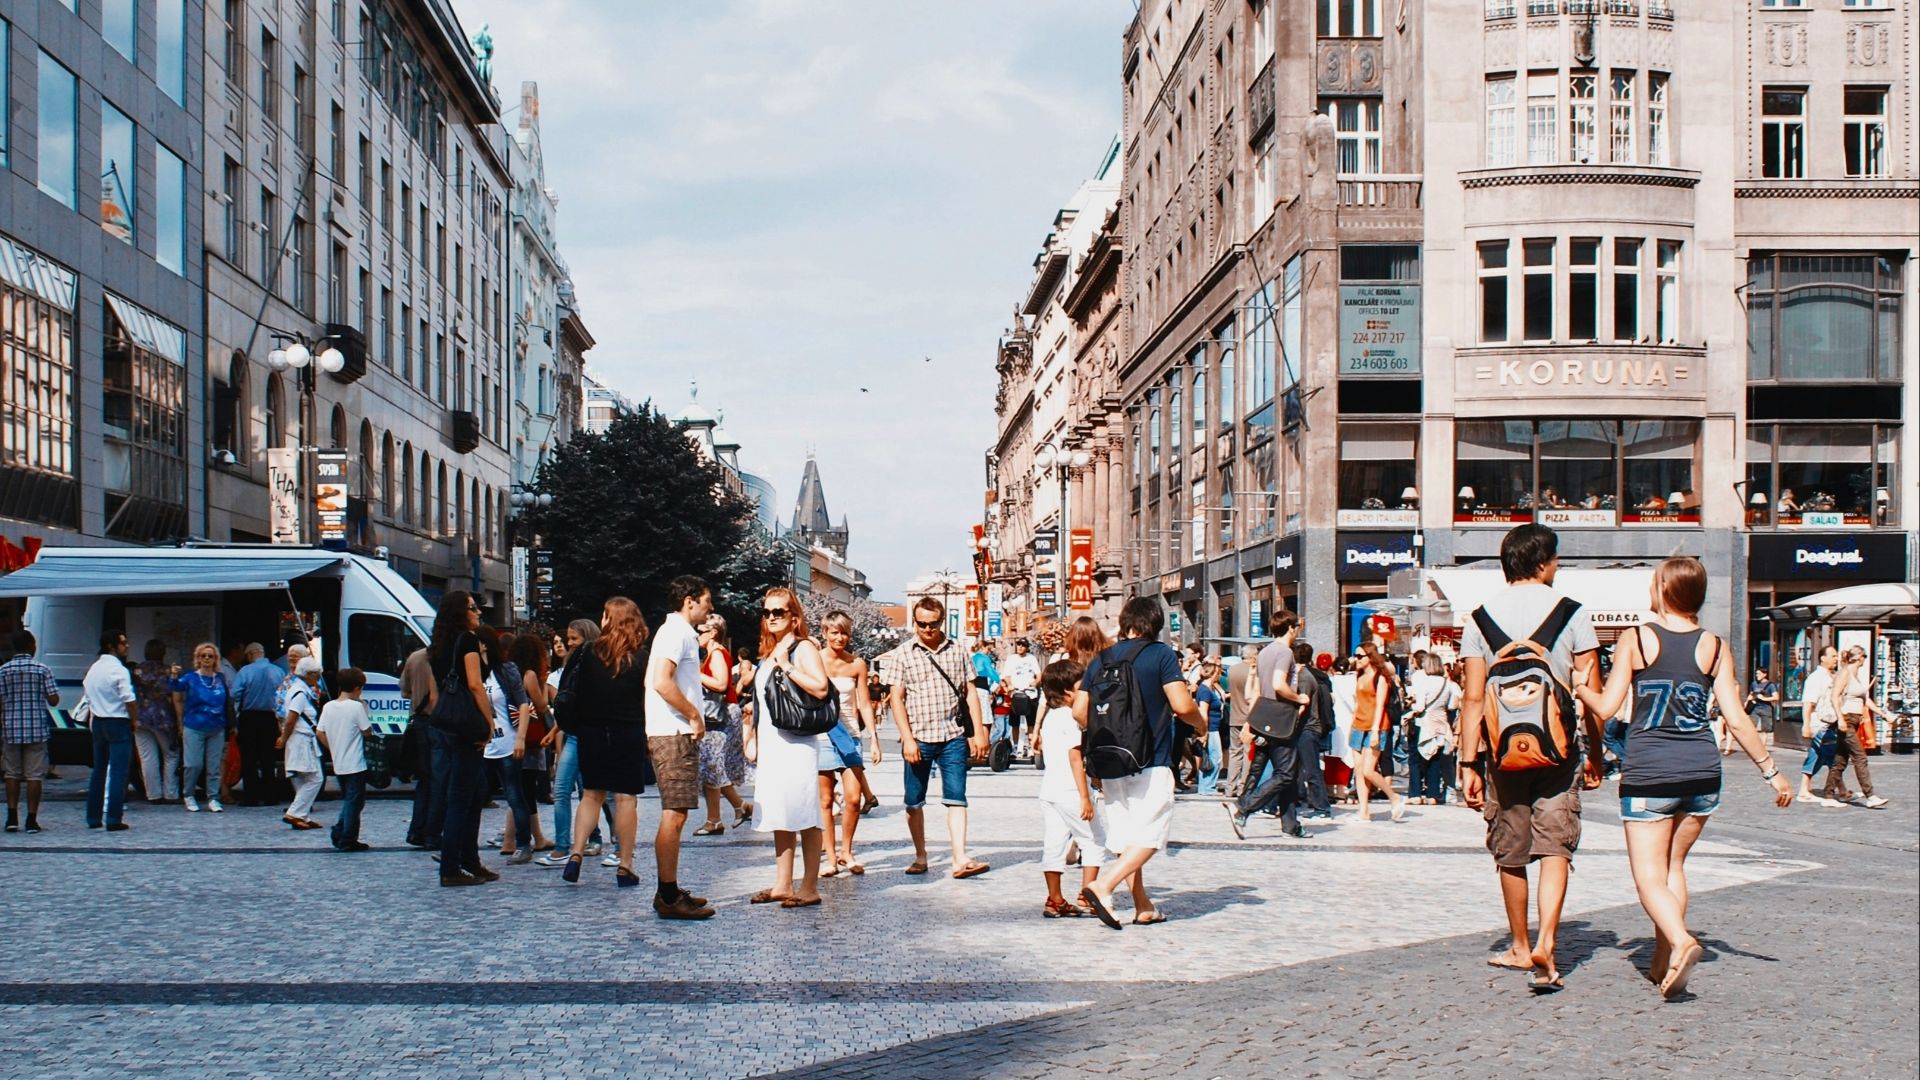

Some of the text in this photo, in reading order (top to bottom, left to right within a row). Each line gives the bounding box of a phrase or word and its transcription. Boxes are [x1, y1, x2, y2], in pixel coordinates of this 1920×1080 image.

[1376, 288, 1401, 296] KORUNA
[1358, 307, 1379, 315] OFFICES
[1353, 332, 1405, 344] 224 217 217
[1350, 358, 1408, 370] 234 603 603
[1499, 359, 1669, 387] KORUNA
[1545, 513, 1607, 523] PIZZA PASTA
[1809, 516, 1838, 525] SALAD
[1591, 614, 1640, 622] LOBASA
[364, 699, 411, 710] OLICIE
[1637, 679, 1709, 732] 73
